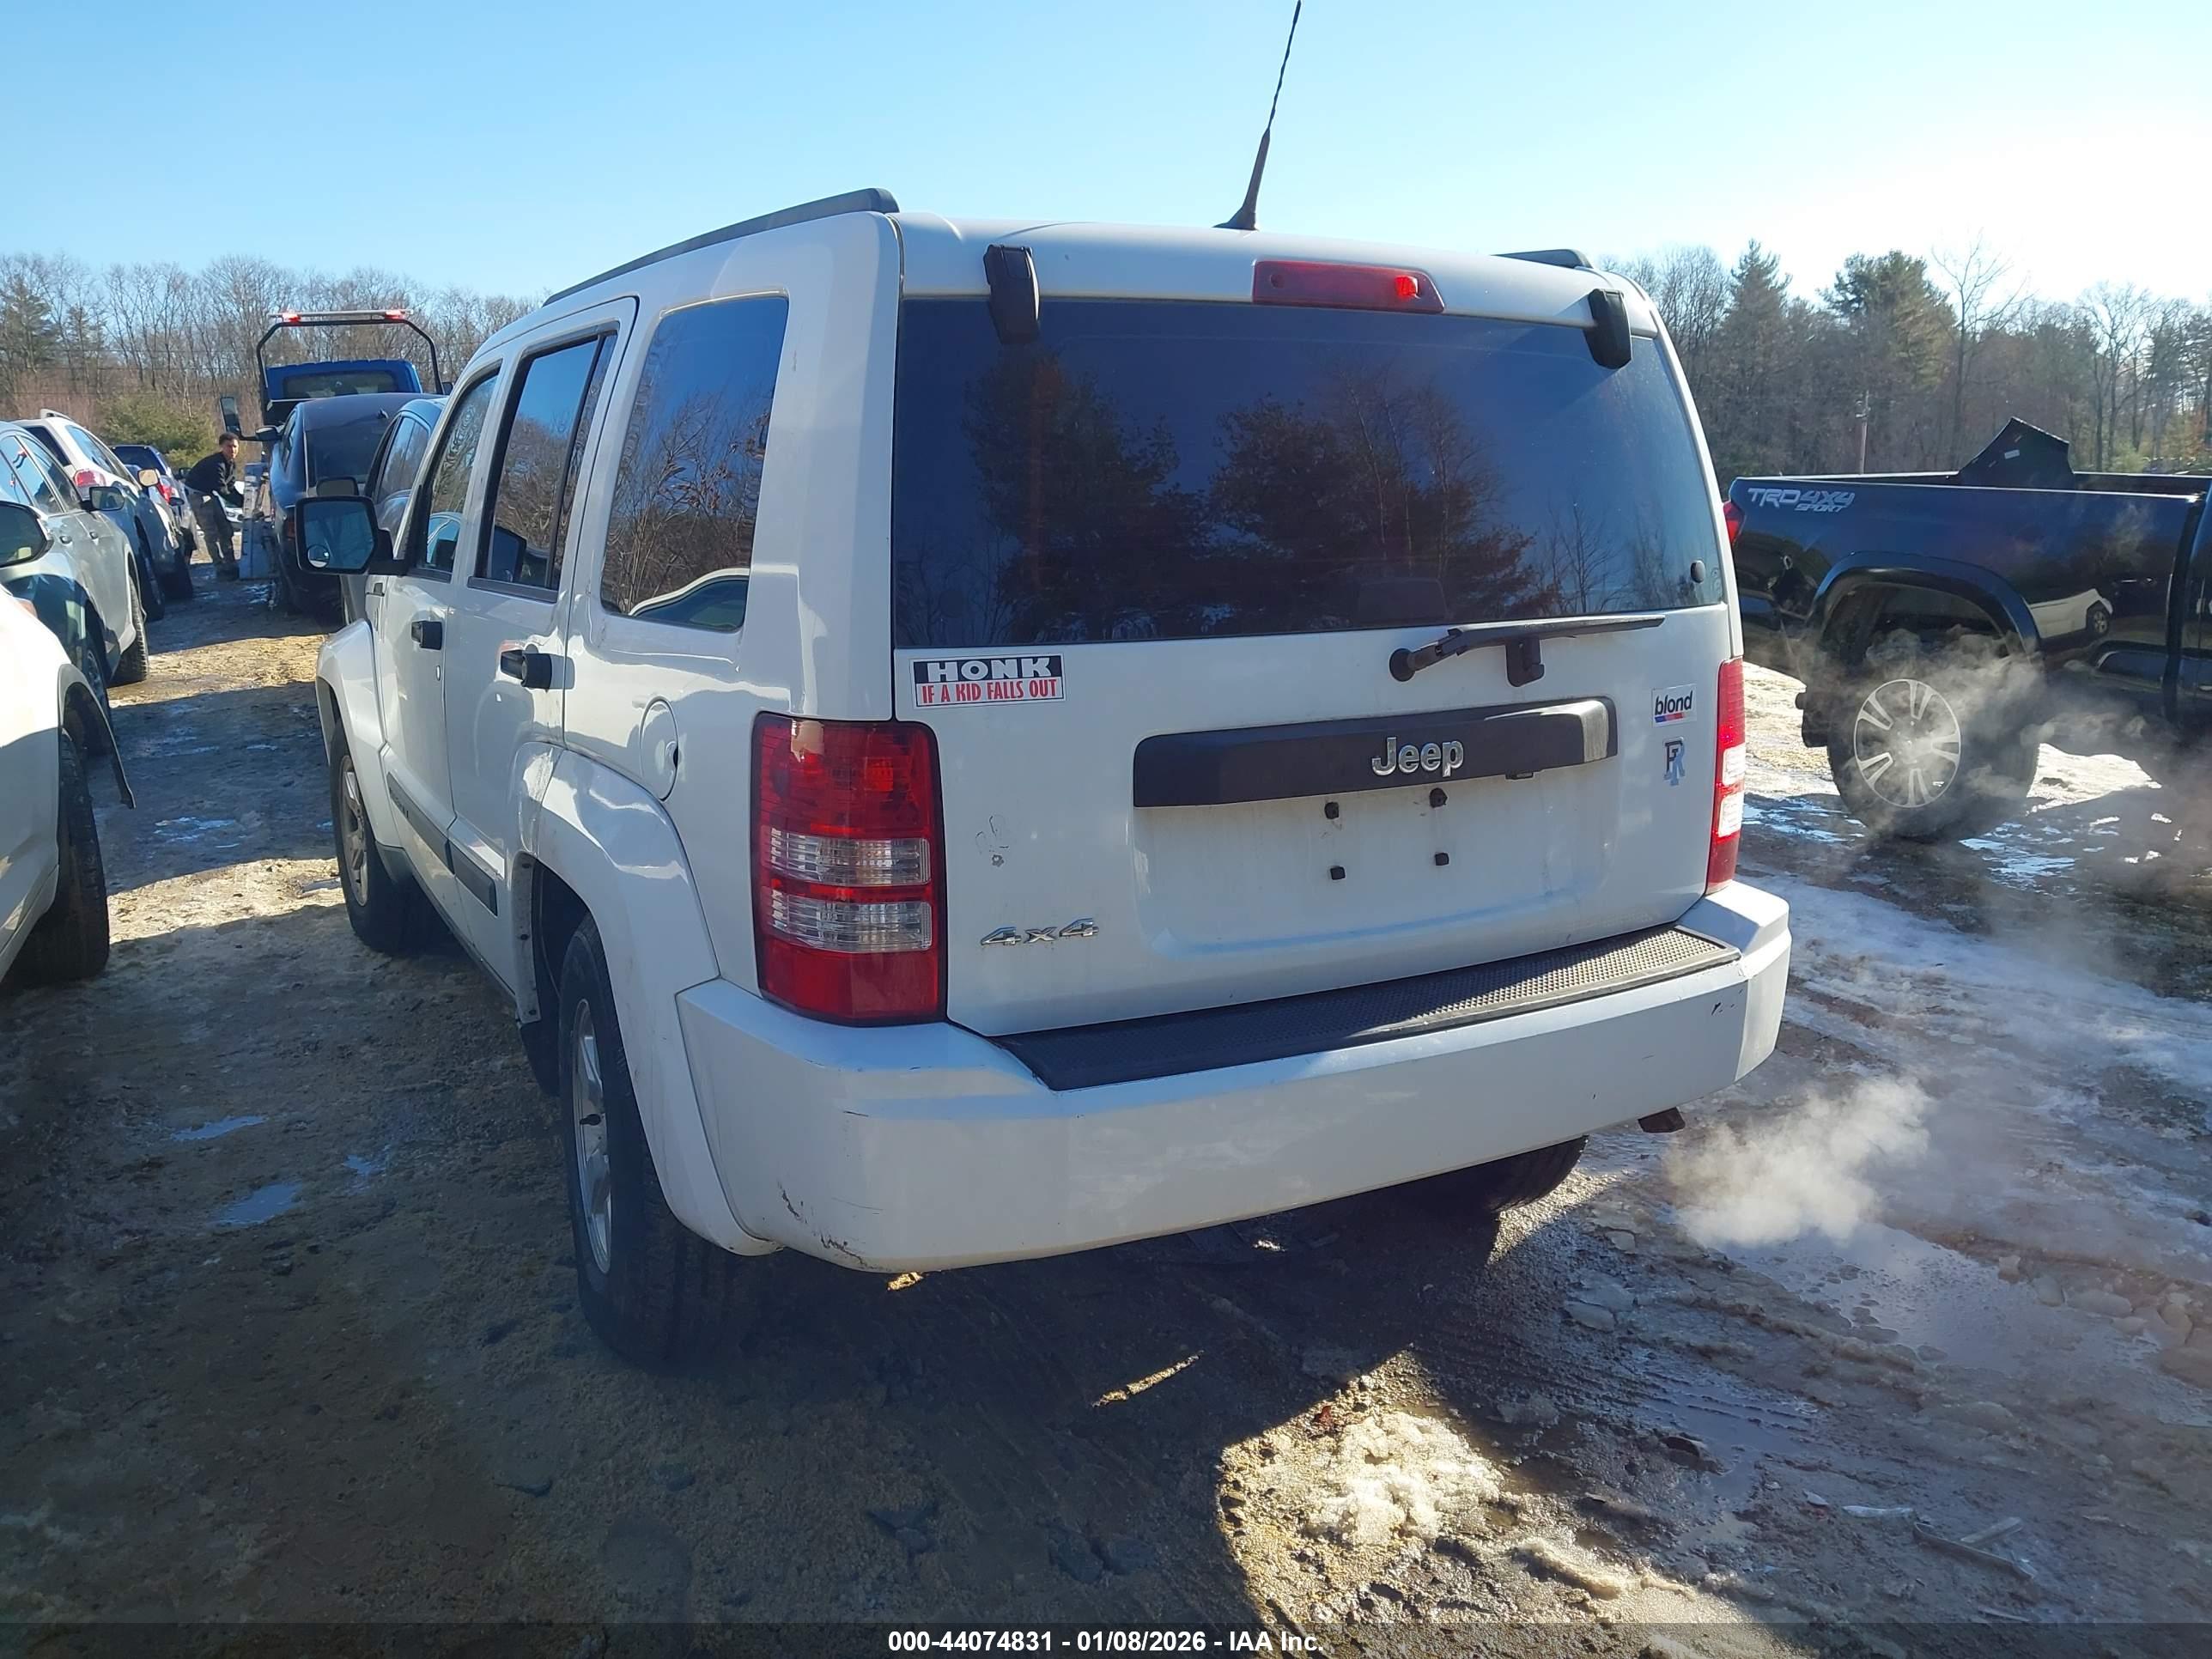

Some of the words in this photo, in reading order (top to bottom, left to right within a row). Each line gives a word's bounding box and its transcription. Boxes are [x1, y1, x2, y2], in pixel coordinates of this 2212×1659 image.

[1747, 487, 1801, 507] TRD
[1794, 502, 1847, 513] SPORT
[927, 657, 1052, 683] HONK
[921, 684, 935, 704] IF
[940, 684, 951, 703] A
[956, 682, 981, 702] KID
[988, 680, 1024, 701] FALLS
[1029, 678, 1058, 698] OUT
[1654, 690, 1693, 716] blond
[1371, 736, 1464, 778] Jeep
